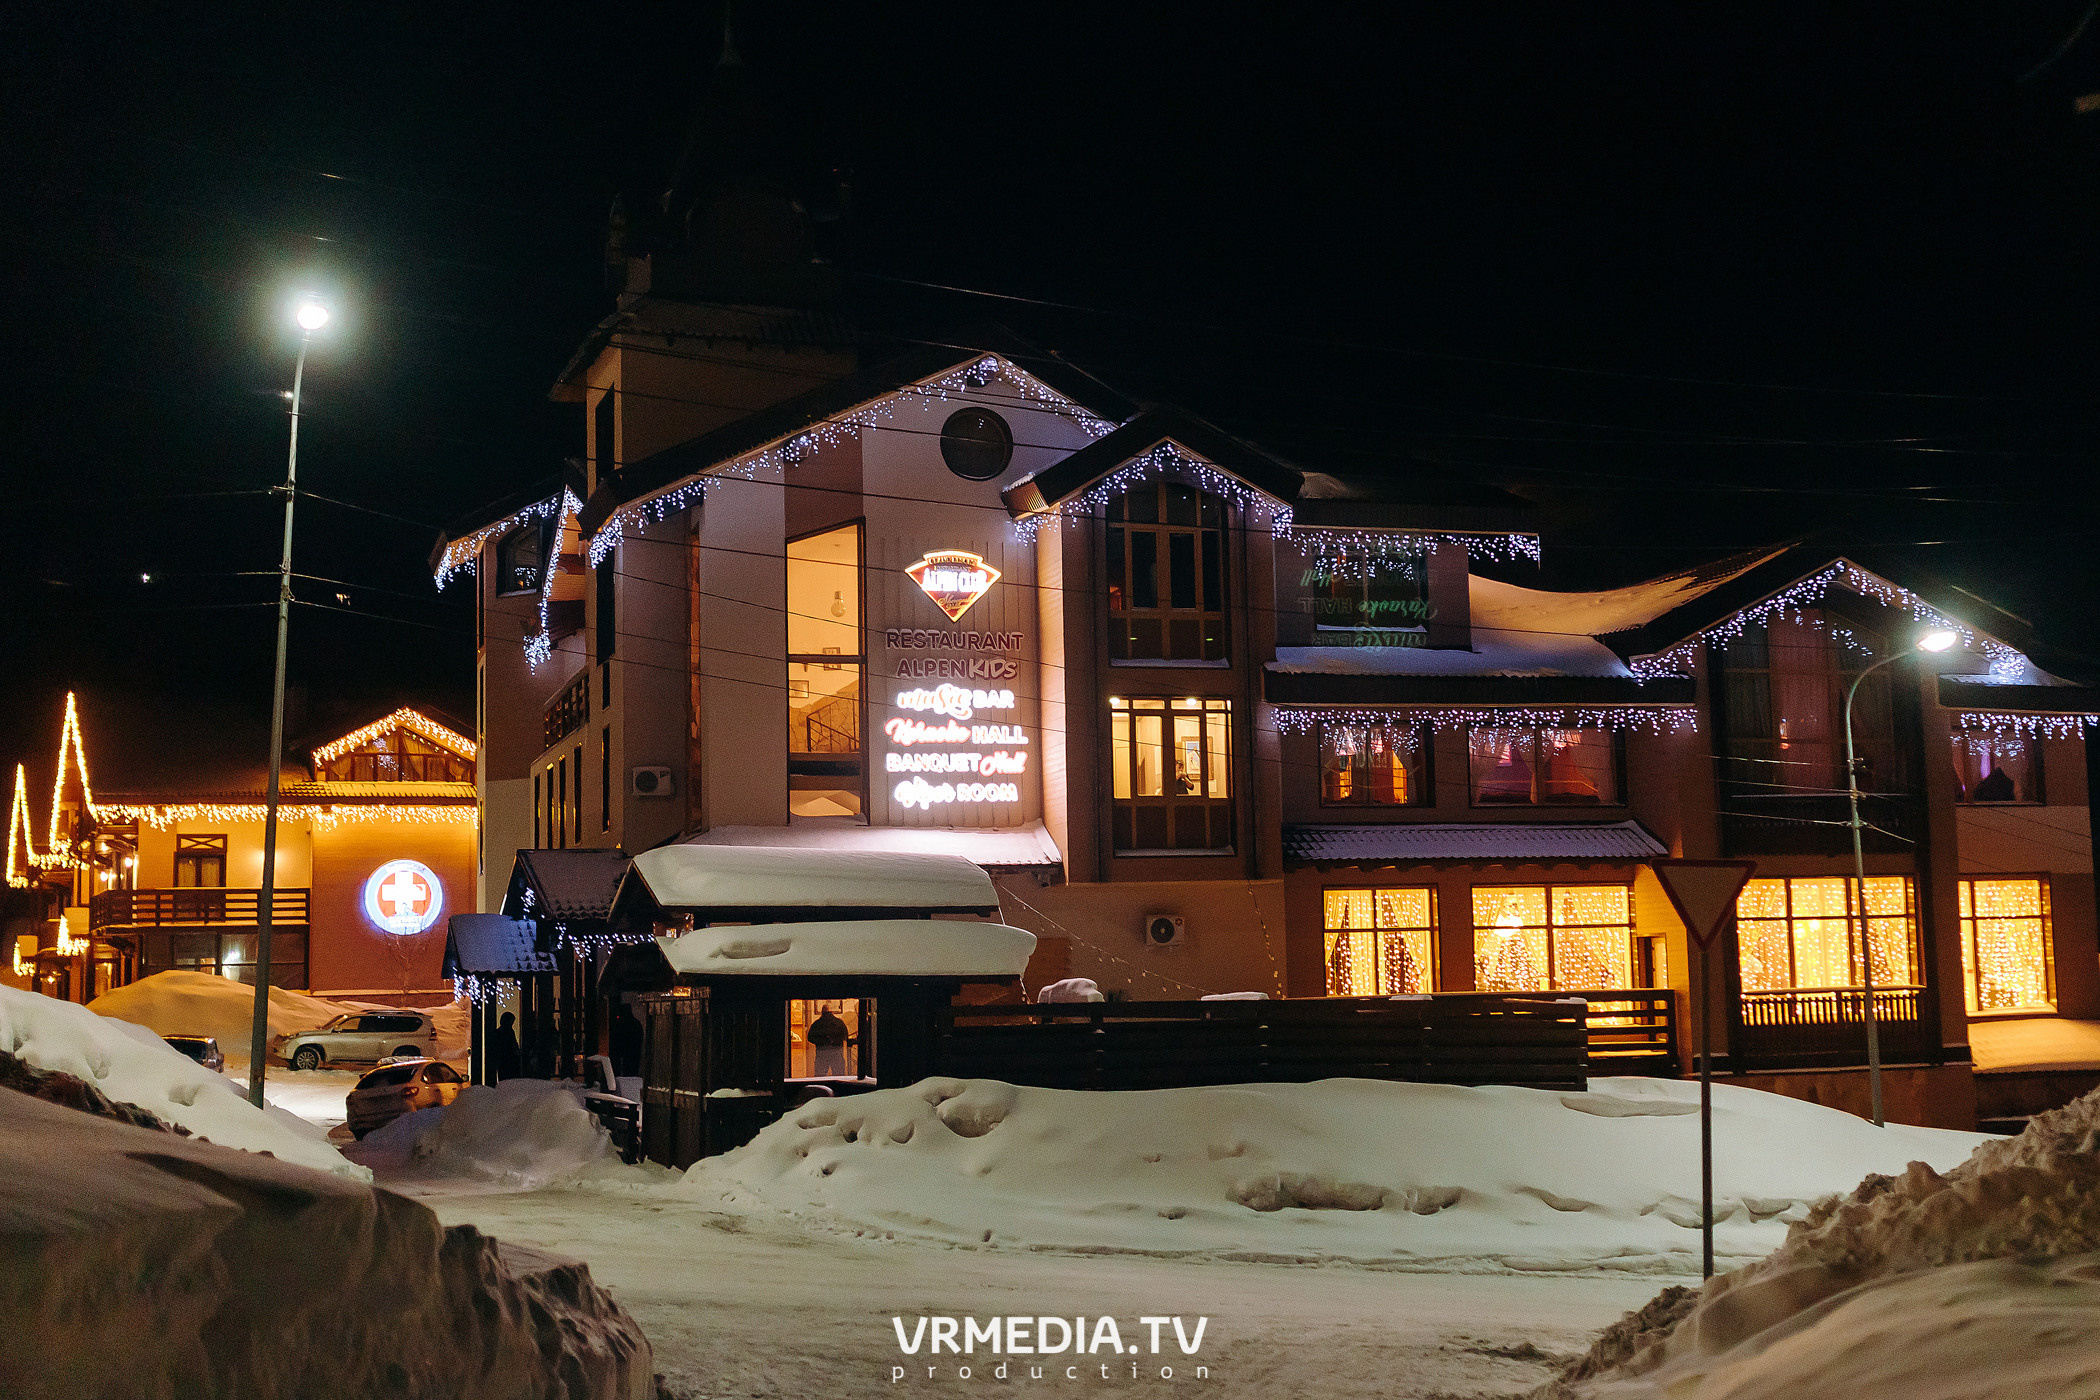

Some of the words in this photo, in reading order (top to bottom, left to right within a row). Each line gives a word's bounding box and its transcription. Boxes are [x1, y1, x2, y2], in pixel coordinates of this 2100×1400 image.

[886, 628, 1024, 652] RESTAURANT
[973, 690, 1015, 709] BAR
[972, 726, 1029, 745] HALL
[886, 753, 980, 774] BANQUET
[956, 783, 1019, 803] ROOM
